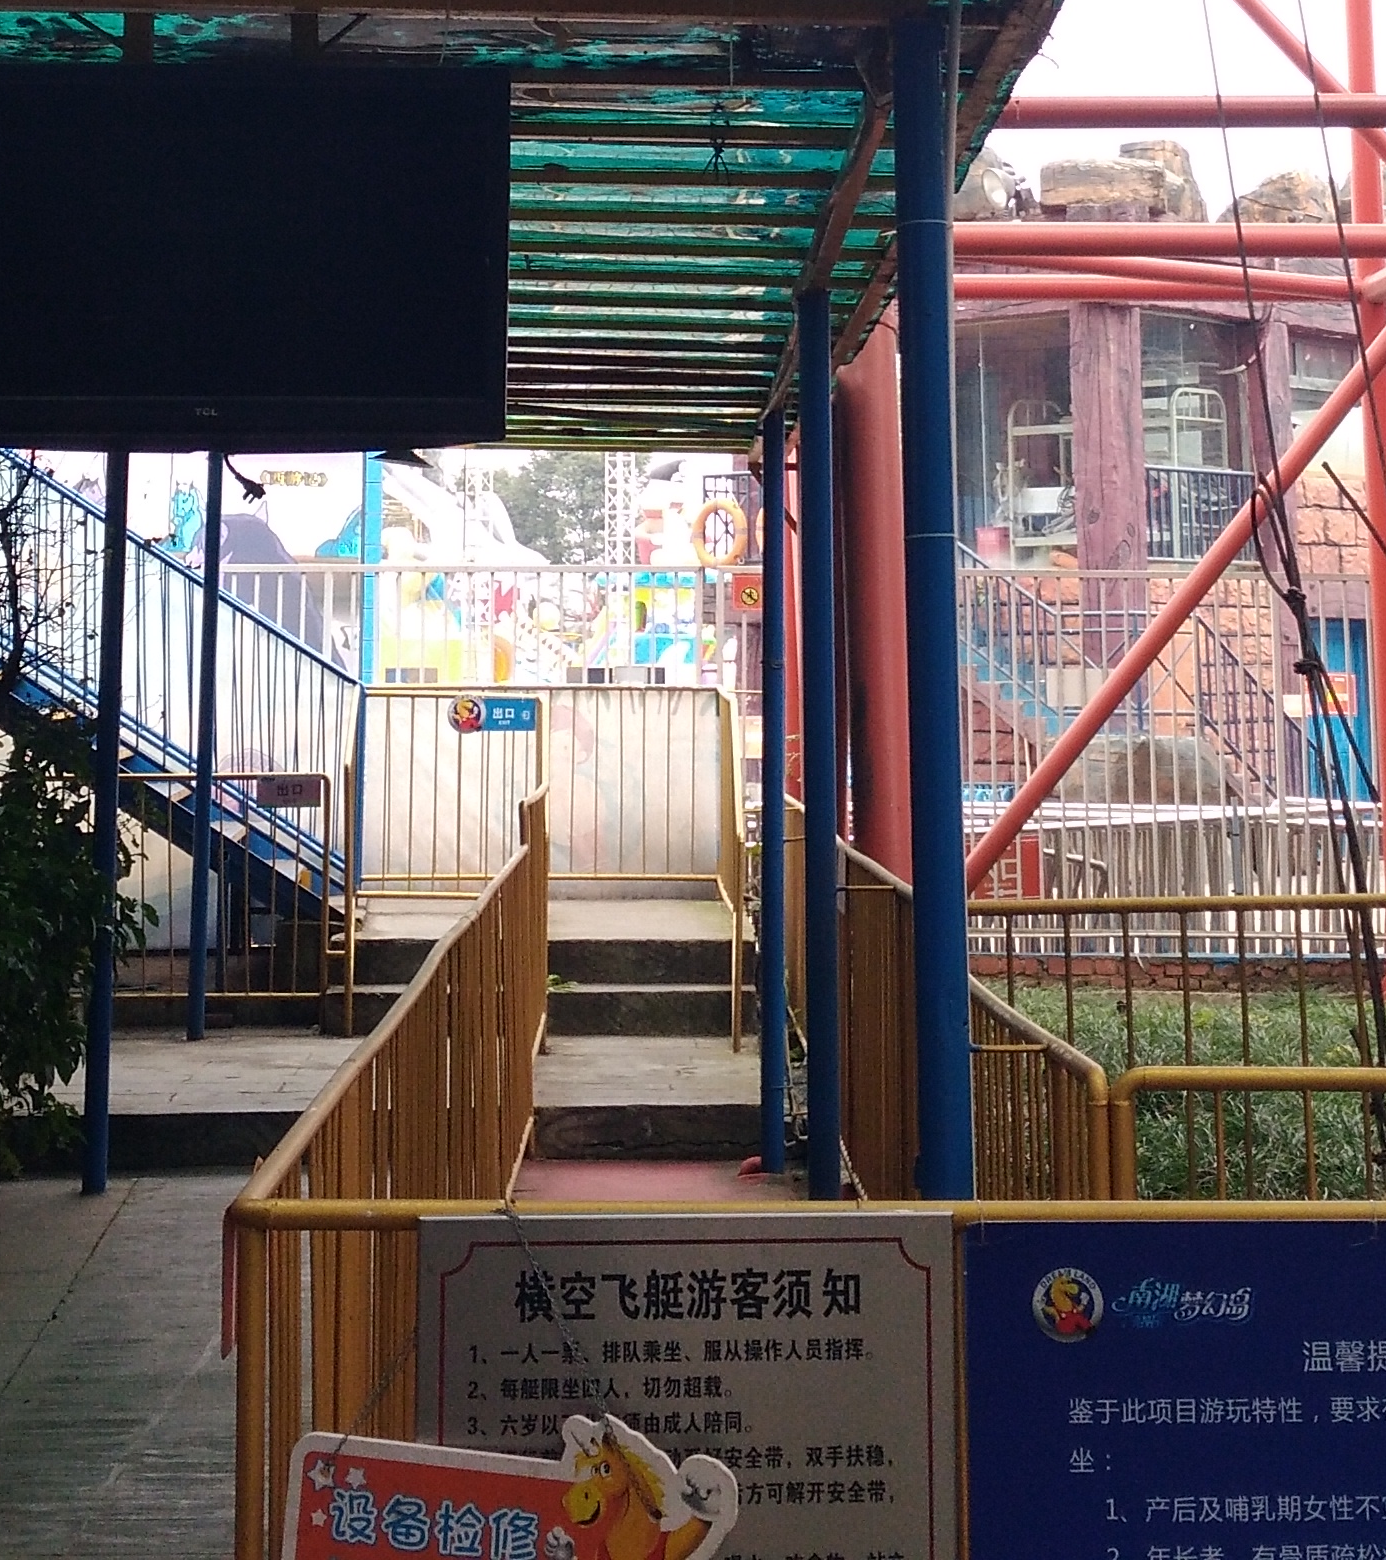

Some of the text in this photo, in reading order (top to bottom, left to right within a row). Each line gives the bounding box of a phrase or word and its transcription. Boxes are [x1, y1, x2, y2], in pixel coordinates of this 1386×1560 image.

[194, 407, 218, 416] TCL
[492, 707, 515, 719] 出口
[277, 784, 303, 796] 出口
[514, 1268, 862, 1322] 横空飞艇游客须知
[329, 1488, 540, 1560] 设备检修
